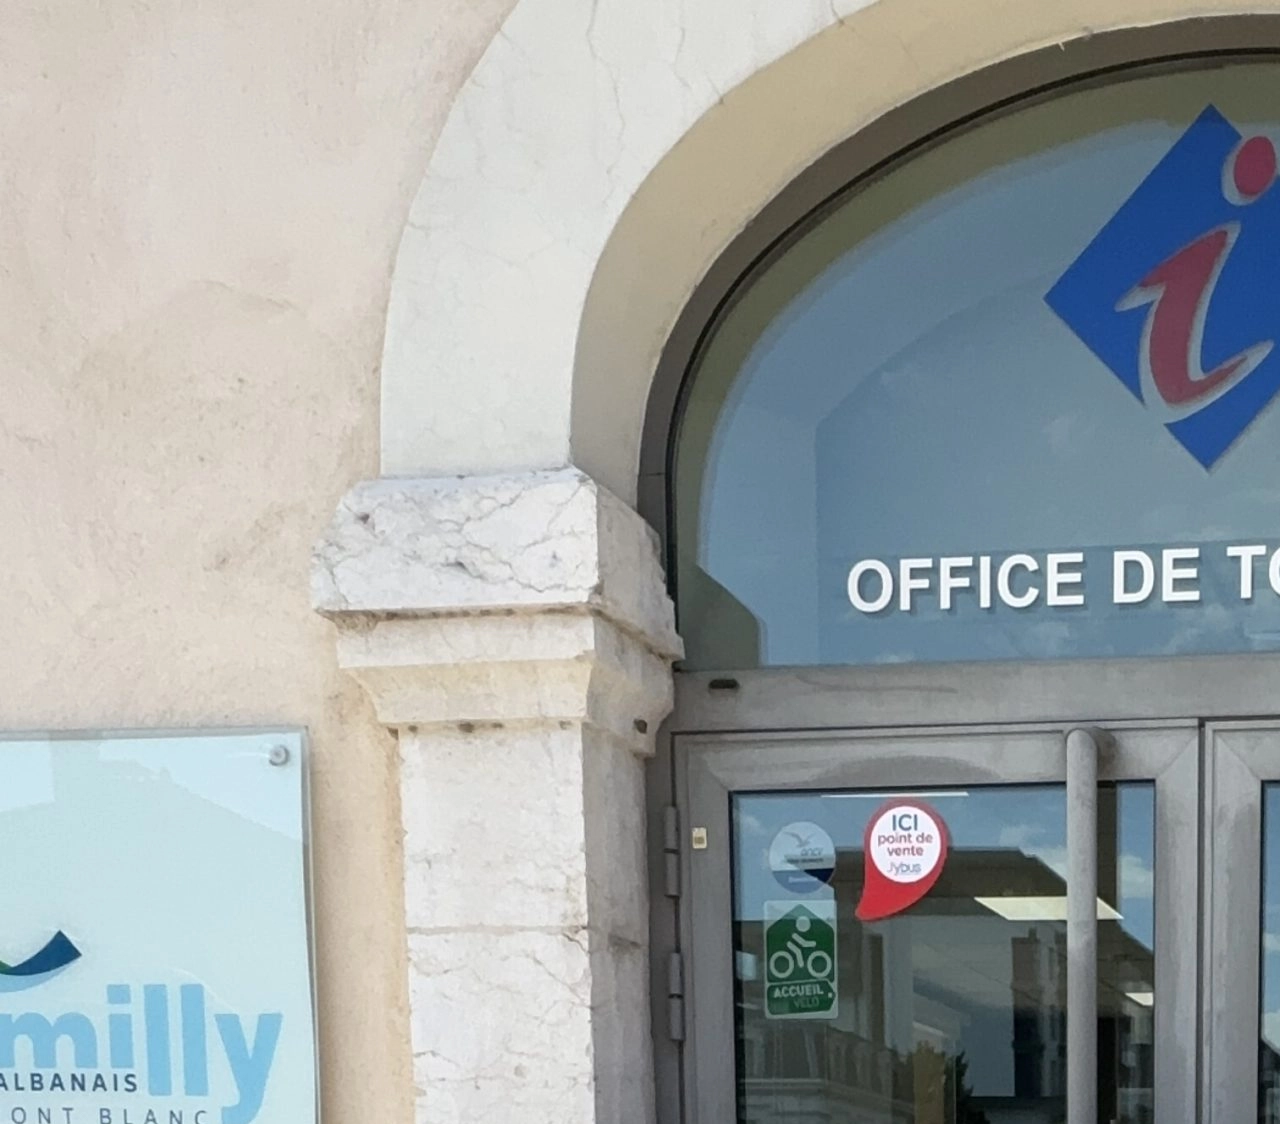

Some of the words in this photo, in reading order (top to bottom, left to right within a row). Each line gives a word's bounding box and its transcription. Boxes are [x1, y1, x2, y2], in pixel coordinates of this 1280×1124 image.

[847, 552, 1084, 612] OFFICE
[1113, 548, 1200, 604] DE
[892, 813, 918, 831] ICI
[878, 833, 912, 847] point
[916, 832, 933, 843] de
[887, 846, 924, 857] vente
[774, 984, 824, 998] ACCUEIL
